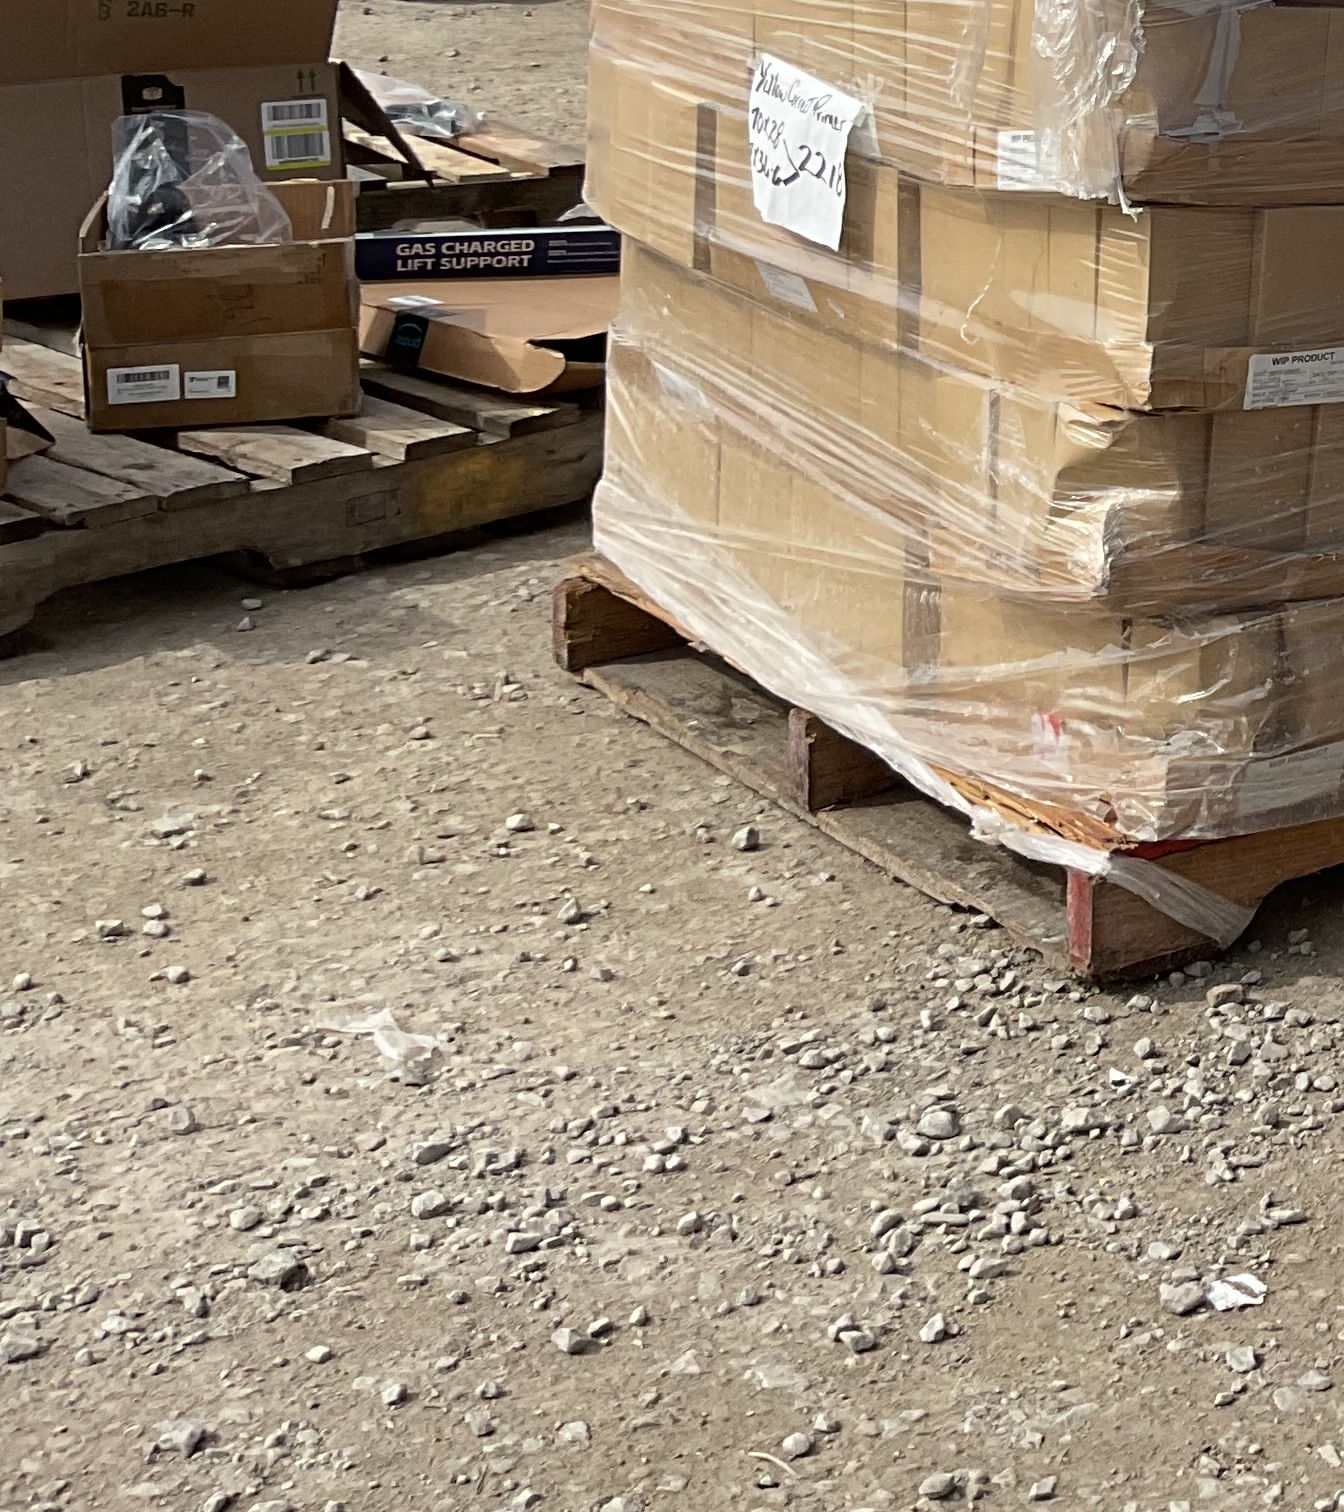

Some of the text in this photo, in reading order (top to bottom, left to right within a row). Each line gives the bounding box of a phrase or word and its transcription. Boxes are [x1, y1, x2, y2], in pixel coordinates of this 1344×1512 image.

[396, 242, 436, 257] GAS
[441, 239, 535, 256] CHARGED
[396, 254, 533, 272] LIFT SUPPORT
[1271, 351, 1336, 367] WIP PRODUCT
